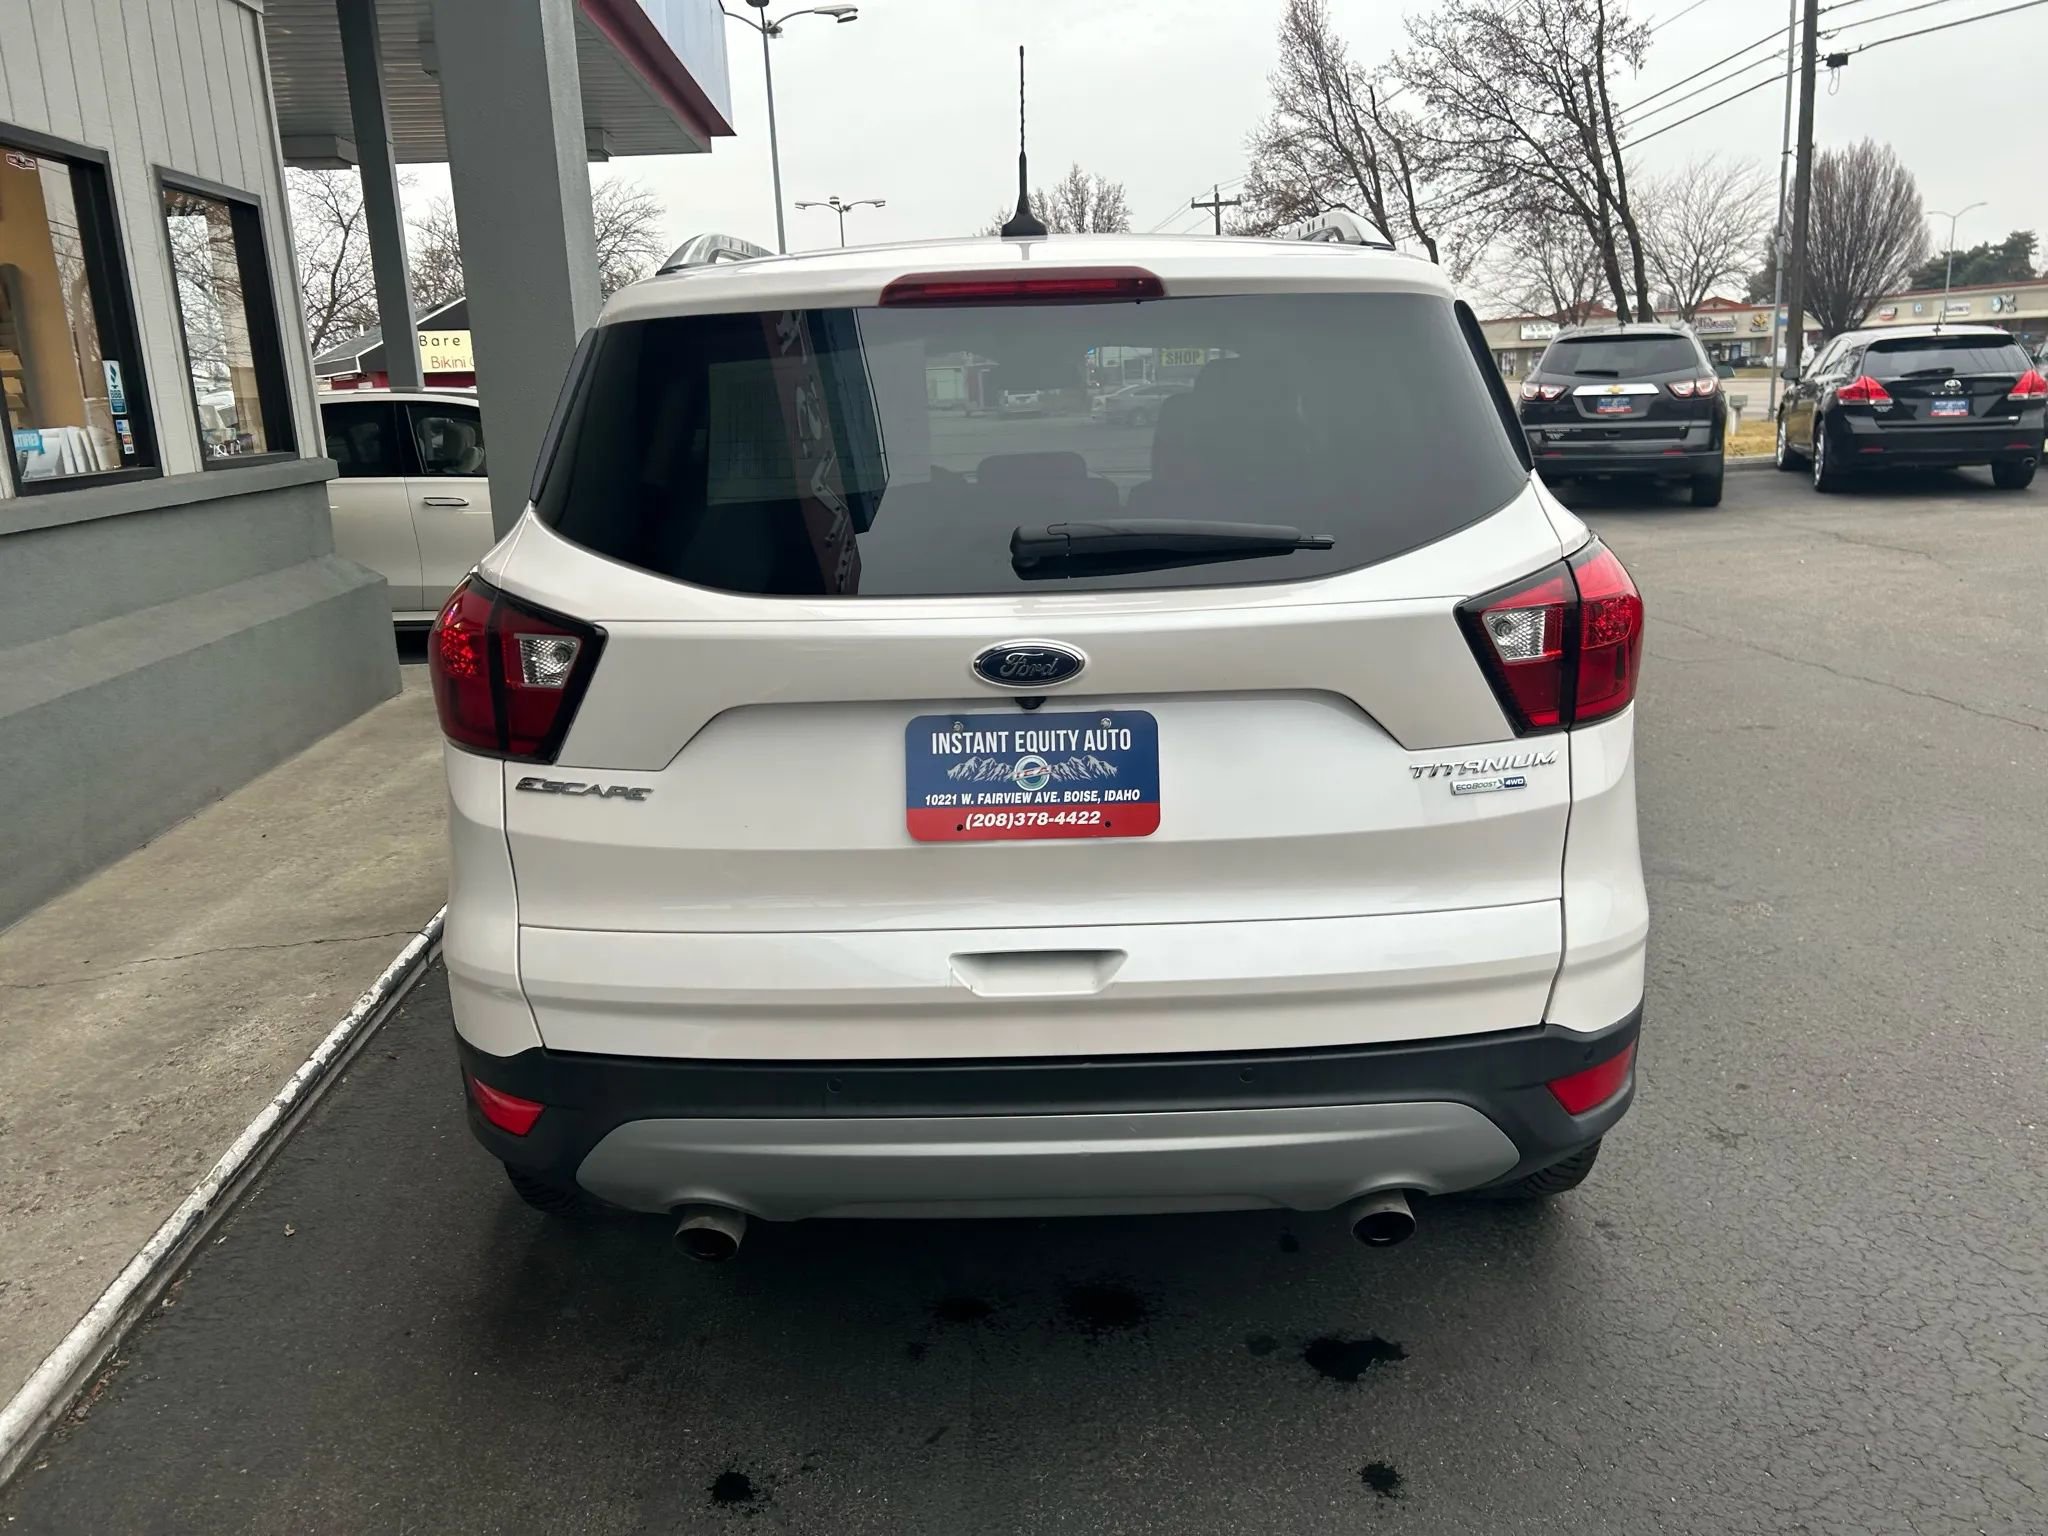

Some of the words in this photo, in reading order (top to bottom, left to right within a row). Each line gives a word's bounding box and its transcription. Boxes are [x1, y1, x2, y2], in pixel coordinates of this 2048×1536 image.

[419, 334, 461, 347] Bare
[431, 355, 466, 369] Bikini
[1166, 351, 1200, 365] SHOP
[1000, 652, 1059, 677] Ford
[932, 731, 1009, 755] INSTANT
[1015, 729, 1079, 753] EQUITY
[1084, 728, 1131, 751] AUTO
[1409, 750, 1559, 779] TITANIUM
[515, 776, 654, 801] ESCAPE
[1505, 778, 1525, 787] 4WD
[925, 793, 957, 806] 10221
[961, 793, 974, 805] W.
[977, 792, 1034, 805] FAIRVIEW
[1034, 791, 1061, 804] AVE.
[1063, 790, 1101, 804] BOISE,
[1104, 789, 1140, 802] IDAHO
[965, 811, 1101, 830] (208)378-4422
